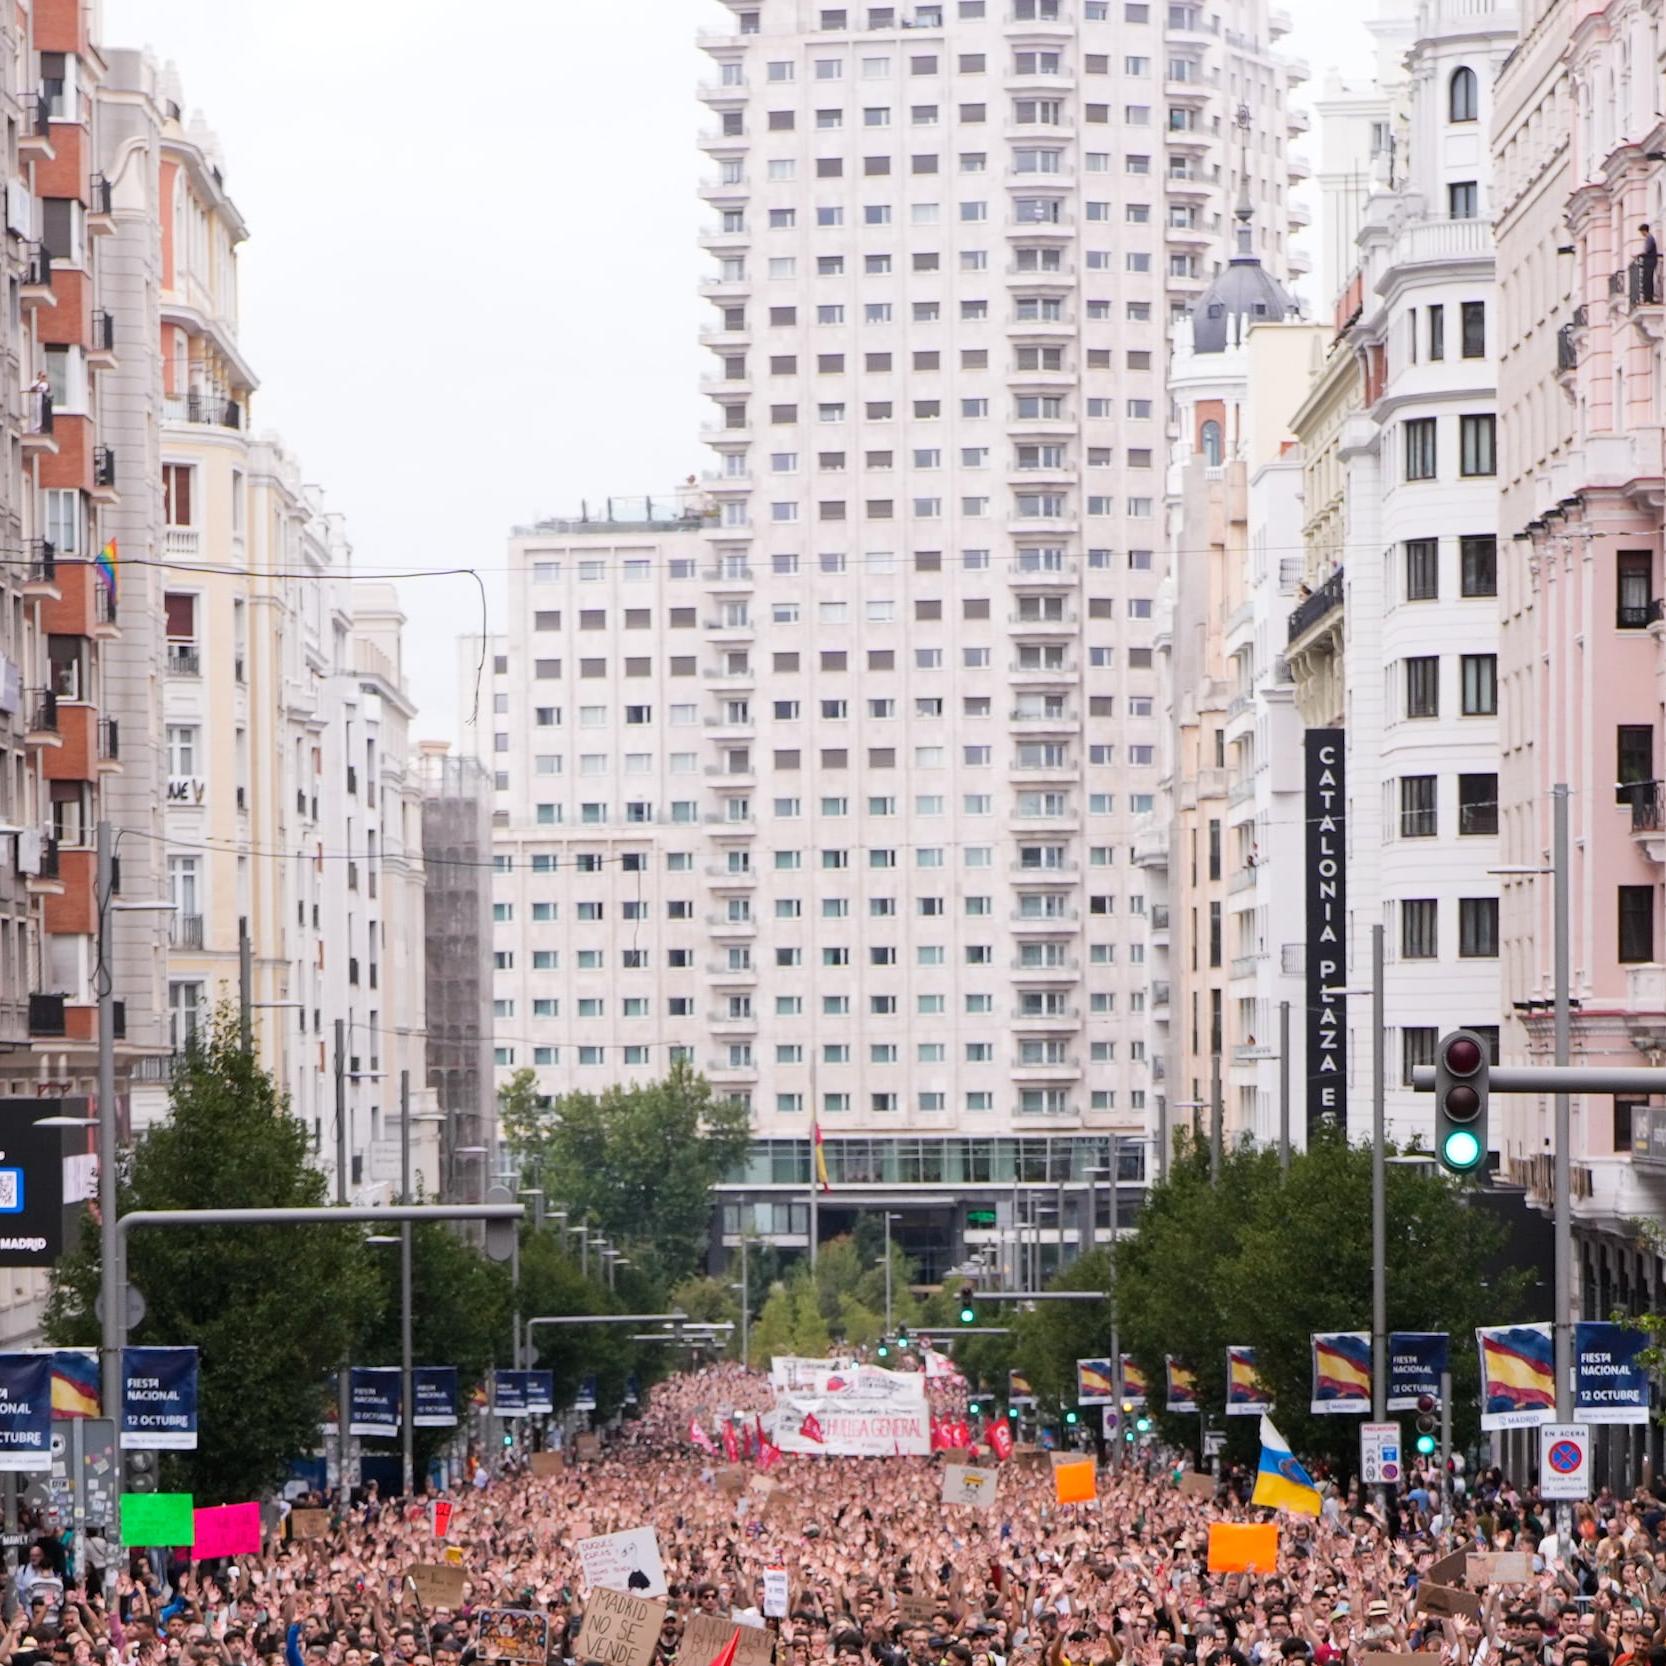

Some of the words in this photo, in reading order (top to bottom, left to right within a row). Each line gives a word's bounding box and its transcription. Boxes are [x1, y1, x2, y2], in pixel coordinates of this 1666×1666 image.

[1318, 745, 1338, 943] CATALONIA
[1318, 960, 1338, 1072] PLAZA
[0, 1237, 47, 1252] MADRID
[1581, 1353, 1611, 1363] FIESTA
[1581, 1365, 1630, 1376] NACIONAL
[127, 1378, 159, 1388] FIESTA
[127, 1390, 179, 1400] NACIONAL
[1581, 1390, 1590, 1400] 12
[1592, 1390, 1639, 1402] OCTUBRE
[127, 1415, 138, 1425] 12
[140, 1415, 188, 1427] OCTUBRE
[1508, 1415, 1539, 1424] MADRID
[827, 1418, 867, 1437] HUELGA
[871, 1417, 923, 1438] GENERAL
[595, 1590, 649, 1620] MADRID
[588, 1614, 611, 1634] NO
[620, 1620, 643, 1644] SE
